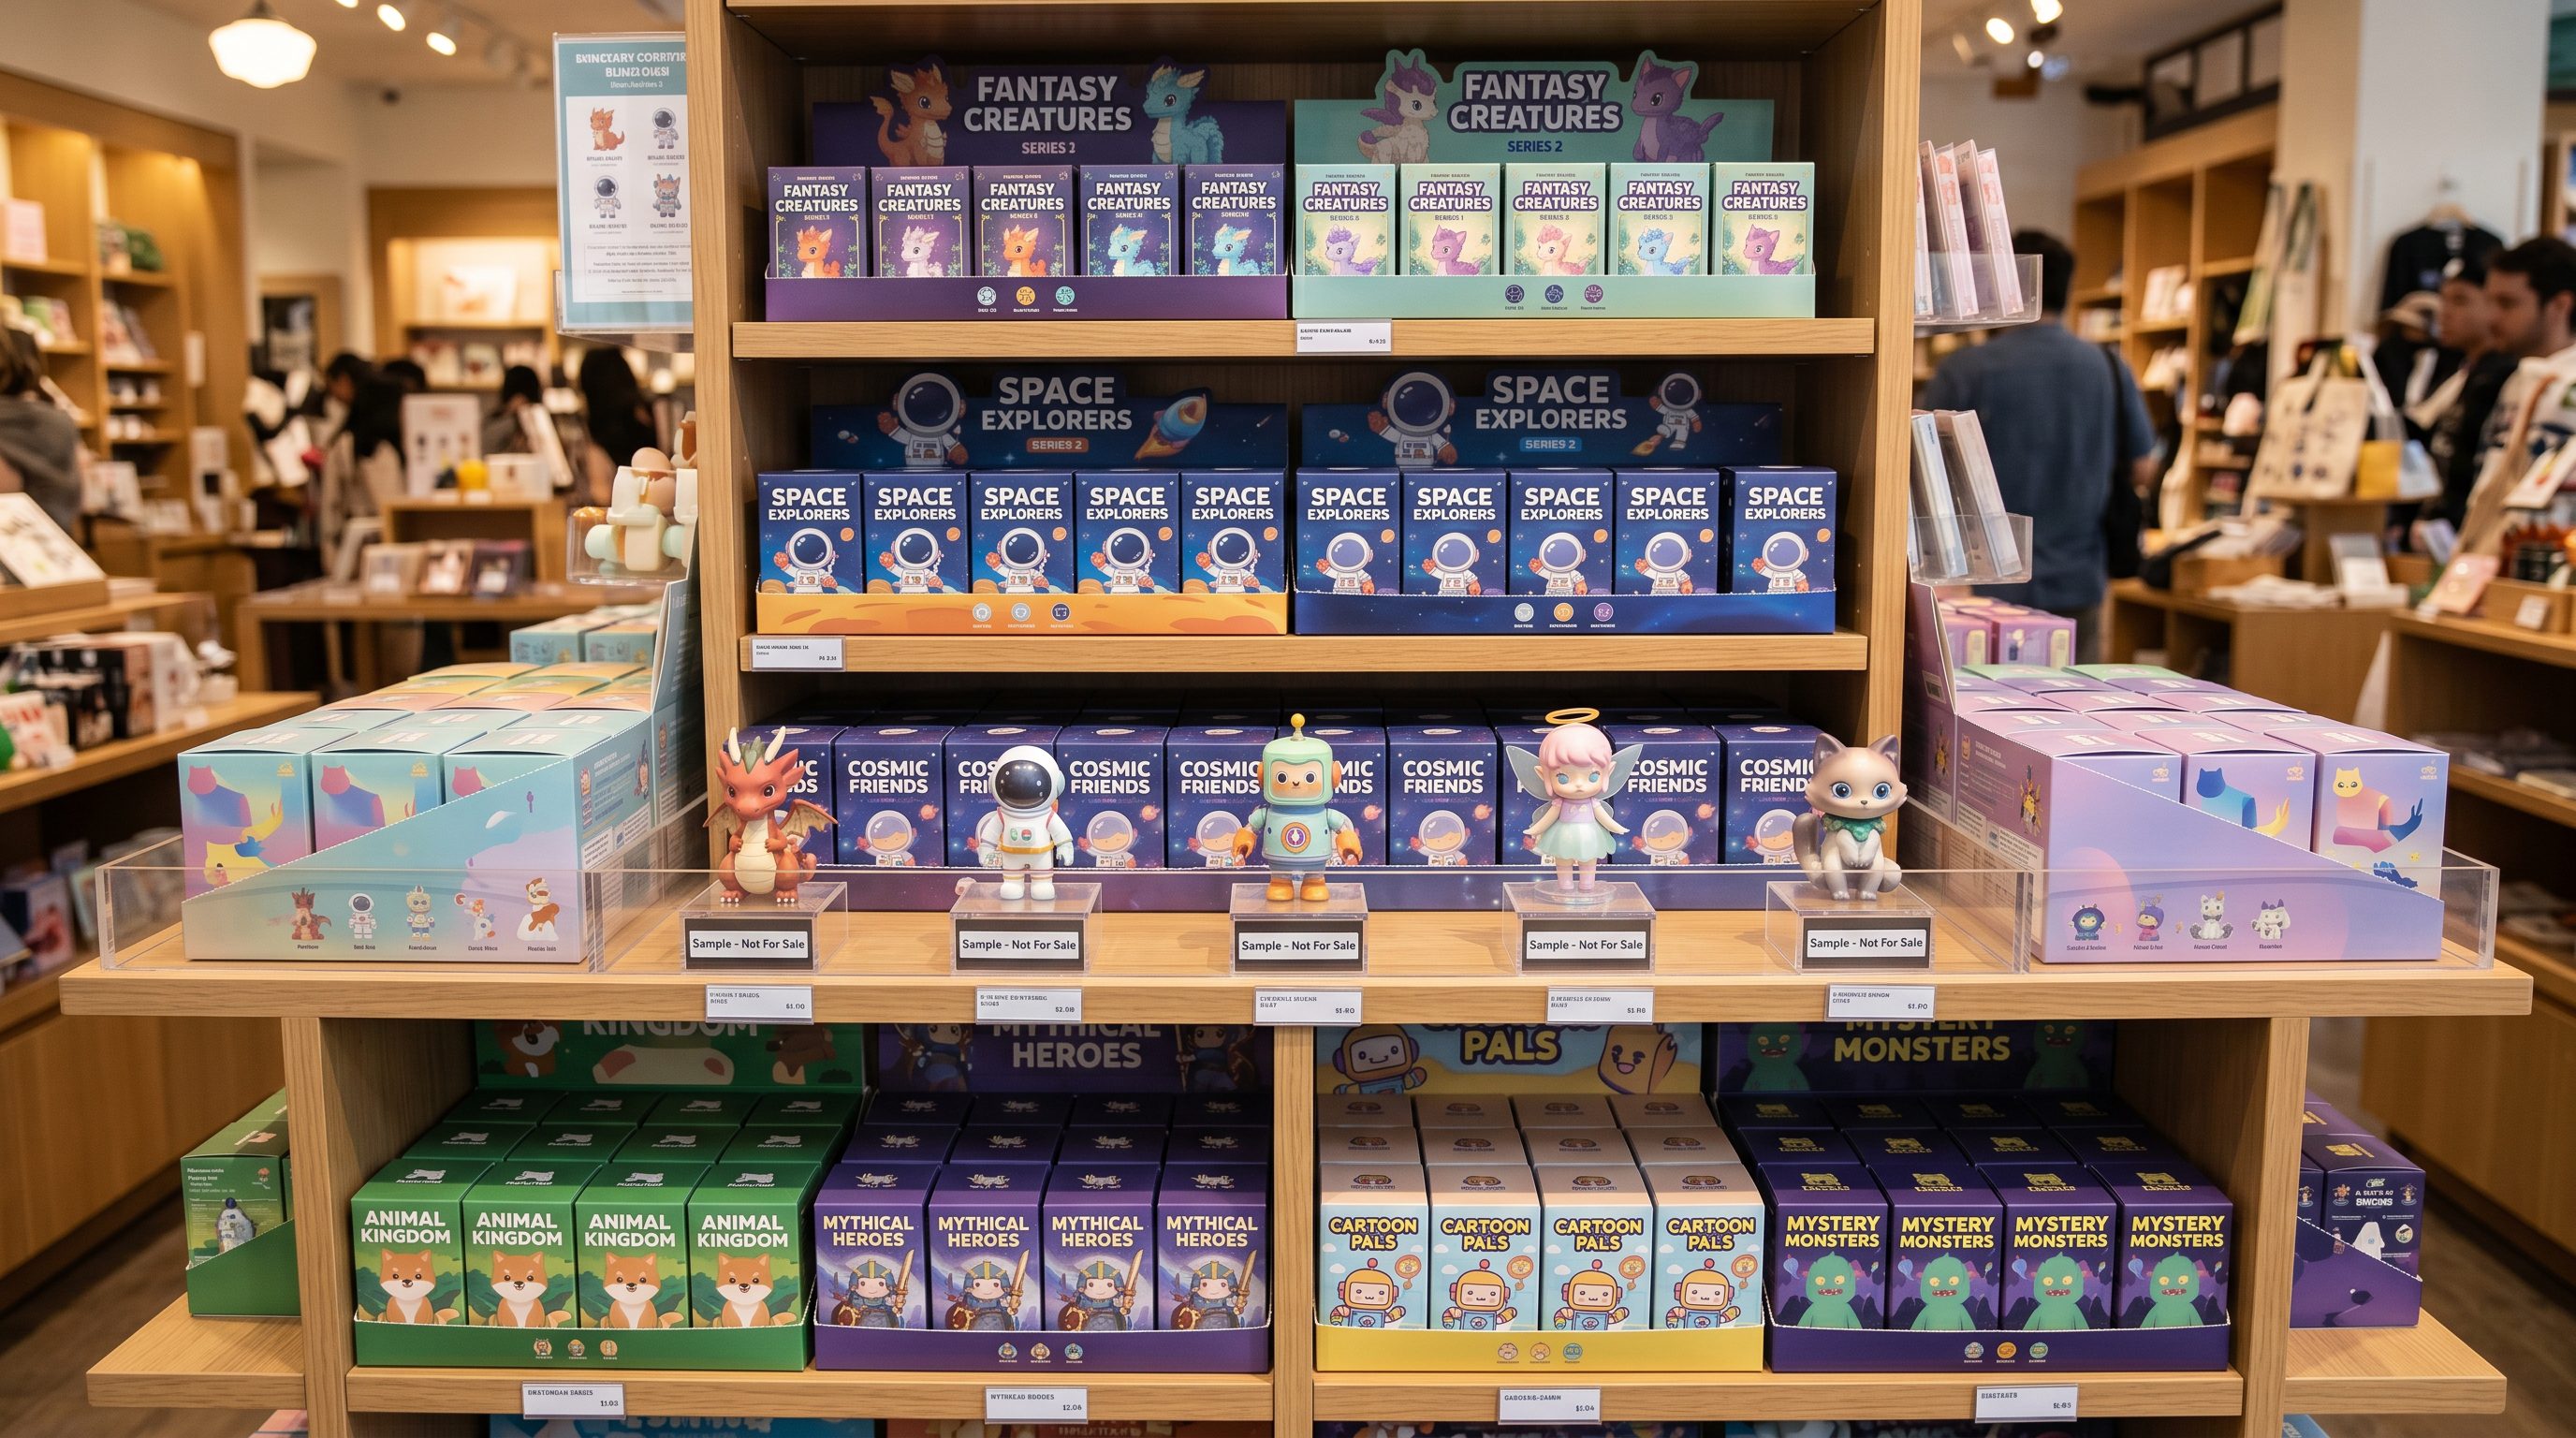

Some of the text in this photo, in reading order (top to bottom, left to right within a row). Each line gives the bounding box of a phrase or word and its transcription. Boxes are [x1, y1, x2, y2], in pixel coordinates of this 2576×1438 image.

[978, 76, 1117, 101] FANTASY
[1466, 74, 1606, 99] FANTASY
[964, 107, 1132, 131] CREATURES
[1451, 105, 1619, 129] CREATURES
[1022, 142, 1065, 154] SERIES
[1508, 140, 1562, 152] SERIES 2
[784, 184, 848, 197] FANTASY
[887, 184, 951, 197] FANTASY
[990, 183, 1055, 195] FANTASY
[1097, 183, 1161, 195] FANTASY
[1202, 182, 1266, 194] FANTASY
[1314, 183, 1378, 196] FANTASY
[1420, 183, 1483, 196] FANTASY
[1525, 183, 1588, 195] FANTASY
[1629, 183, 1692, 195] FANTASY
[1734, 183, 1797, 195] FANTASY
[776, 199, 857, 212] CREATURES
[879, 198, 960, 212] CREATURES
[982, 198, 1063, 211] CREATURES
[1088, 198, 1171, 210] CREATURES
[1193, 197, 1276, 209] CREATURES
[1305, 198, 1386, 210] CREATURES
[1411, 198, 1490, 209] CREATURES
[1515, 198, 1597, 209] CREATURES
[1619, 197, 1700, 209] CREATURES
[1724, 197, 1806, 209] CREATURES
[1000, 377, 1114, 404] SPACE
[1493, 375, 1609, 404] SPACE
[982, 410, 1132, 430] EXPLORERS
[1476, 409, 1627, 429] EXPLORERS
[1032, 441, 1082, 449] SERIES 2
[1526, 440, 1575, 448] SERIES 2
[772, 488, 846, 506] SPACE
[879, 488, 952, 506] SPACE
[985, 488, 1059, 506] SPACE
[1090, 488, 1164, 505] SPACE
[1195, 487, 1270, 505] SPACE
[1311, 488, 1386, 506] SPACE
[1418, 488, 1492, 506] SPACE
[1525, 488, 1599, 506] SPACE
[1631, 488, 1705, 506] SPACE
[1749, 487, 1822, 505] SPACE
[768, 508, 850, 520] EXPLORERS
[875, 508, 956, 520] EXPLORERS
[981, 508, 1062, 520] EXPLORERS
[1087, 508, 1168, 520] EXPLORERS
[1193, 508, 1273, 520] EXPLORERS
[1308, 509, 1389, 520] EXPLORERS
[1414, 508, 1496, 520] EXPLORERS
[1521, 508, 1603, 520] EXPLORERS
[1627, 508, 1709, 520] EXPLORERS
[1746, 508, 1825, 520] EXPLORERS
[848, 760, 929, 776] COSMIC
[959, 761, 998, 777] COS
[1070, 761, 1150, 777] COSMIC
[1180, 760, 1259, 777] COSMIC
[1403, 760, 1484, 776] COSMIC
[850, 779, 928, 793] FRIENDS
[1072, 780, 1149, 794] FRIENDS
[1181, 779, 1260, 794] FRIENDS
[1404, 779, 1483, 793] FRIENDS
[1628, 778, 1707, 792] FRIENDS
[1741, 777, 1808, 792] FRIEND
[693, 939, 731, 950] Sample
[742, 939, 760, 948] Not
[764, 939, 780, 948] For
[783, 939, 804, 948] Sale
[962, 940, 1002, 951] Sample
[1013, 940, 1031, 948] Not
[1034, 940, 1051, 948] For
[1054, 941, 1076, 949] Sale
[1242, 941, 1281, 952] Sample
[1292, 941, 1310, 950] Not
[1314, 941, 1330, 950] For
[1334, 941, 1355, 950] Sale
[1530, 940, 1569, 951] Sample
[1579, 940, 1598, 949] Not
[1602, 940, 1617, 949] For
[1620, 940, 1643, 948] Sale
[1810, 938, 1849, 949] Sample
[1860, 938, 1878, 947] Not
[1881, 938, 1897, 946] For
[1901, 938, 1923, 946] Sale
[1464, 1031, 1558, 1061] PALS
[1835, 1036, 2010, 1062] MONSTERS
[1014, 1042, 1141, 1068] HEROES
[365, 1211, 446, 1226] ANIMAL
[476, 1212, 557, 1228] ANIMAL
[589, 1214, 670, 1229] ANIMAL
[702, 1215, 783, 1230] ANIMAL
[824, 1216, 914, 1230] MYTHICAL
[939, 1217, 1029, 1230] MYTHICAL
[1053, 1216, 1143, 1230] MYTHICAL
[1167, 1216, 1258, 1230] MYTHICAL
[1330, 1218, 1416, 1233] CARTOON
[1788, 1216, 1879, 1232] MYSTERY
[1902, 1217, 1994, 1232] MYSTERY
[2016, 1216, 2107, 1232] MYSTERY
[2132, 1215, 2224, 1232] MYSTERY
[1442, 1219, 1529, 1234] CARTOON
[1556, 1220, 1642, 1234] CARTOON
[1668, 1219, 1754, 1233] CARTOON
[361, 1228, 450, 1243] KINGDOM
[473, 1231, 562, 1245] KINGDOM
[585, 1232, 675, 1247] KINGDOM
[698, 1233, 787, 1247] KINGDOM
[833, 1232, 904, 1246] HEROES
[948, 1233, 1019, 1247] HEROES
[1062, 1233, 1133, 1246] HEROES
[1177, 1233, 1248, 1246] HEROES
[1351, 1234, 1397, 1249] PALS
[1464, 1235, 1508, 1250] PALS
[1576, 1235, 1620, 1250] PALS
[1689, 1235, 1734, 1249] PALS
[1785, 1234, 1880, 1247] MONSTERS
[1900, 1235, 1993, 1248] MONSTERS
[2014, 1234, 2107, 1247] MONSTERS
[2130, 1234, 2223, 1247] MONSTERS
